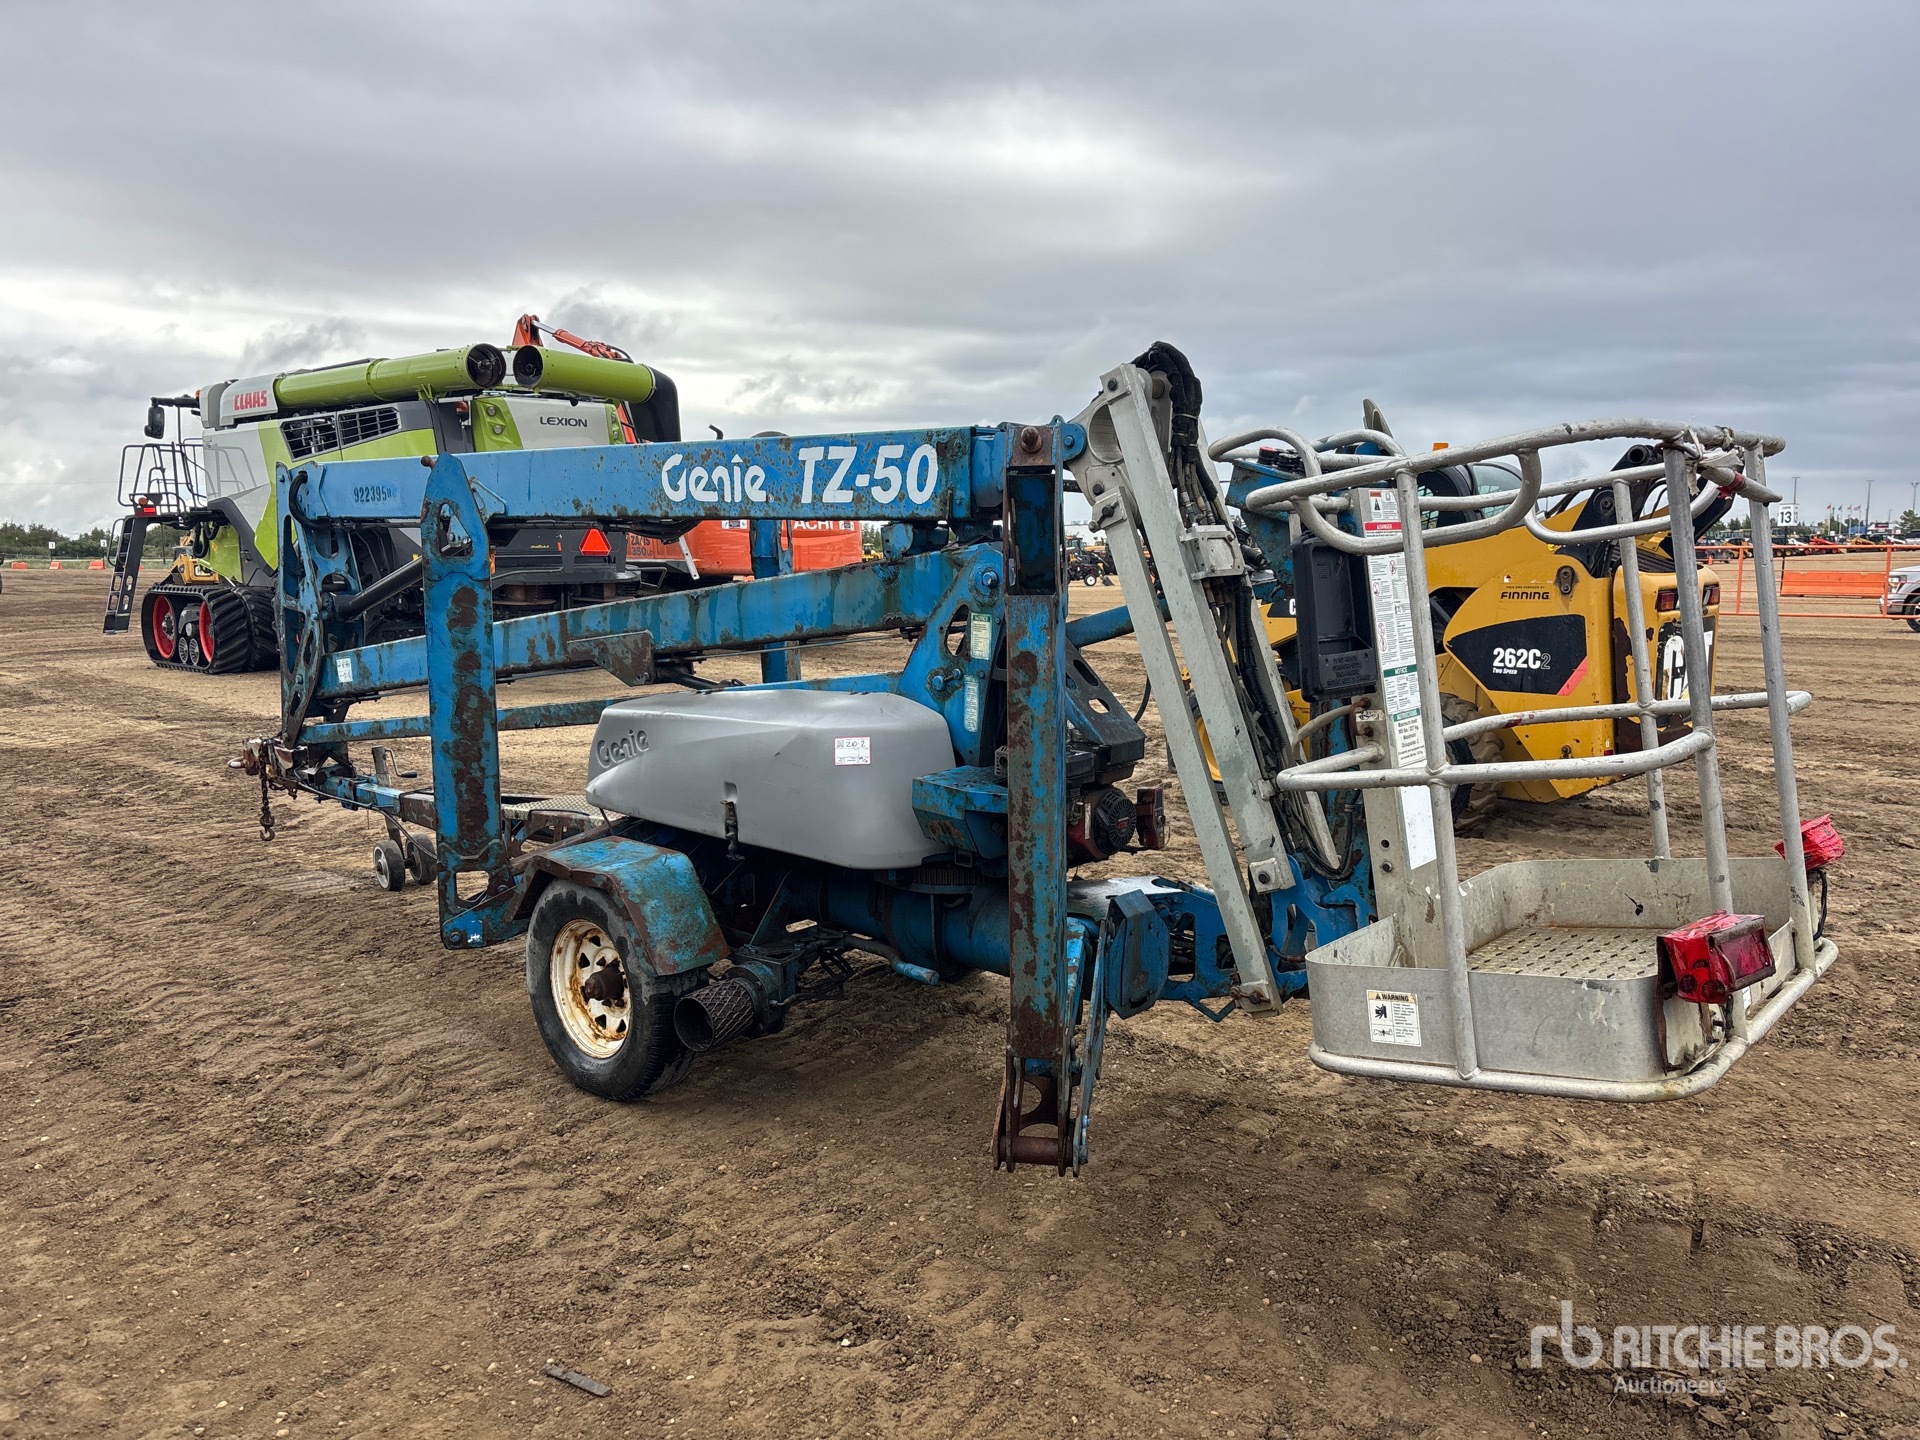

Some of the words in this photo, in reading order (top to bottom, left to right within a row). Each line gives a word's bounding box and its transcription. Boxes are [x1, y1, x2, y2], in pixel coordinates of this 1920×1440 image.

[234, 390, 267, 410] CLAAS
[540, 416, 588, 428] LEXION
[661, 453, 767, 503] Genie
[798, 444, 938, 505] TZ-50
[1780, 511, 1792, 524] 13
[1500, 591, 1550, 600] FINNING
[1394, 667, 1408, 675] NOTICE
[596, 728, 650, 769] Genie
[1381, 993, 1410, 1002] WARNING
